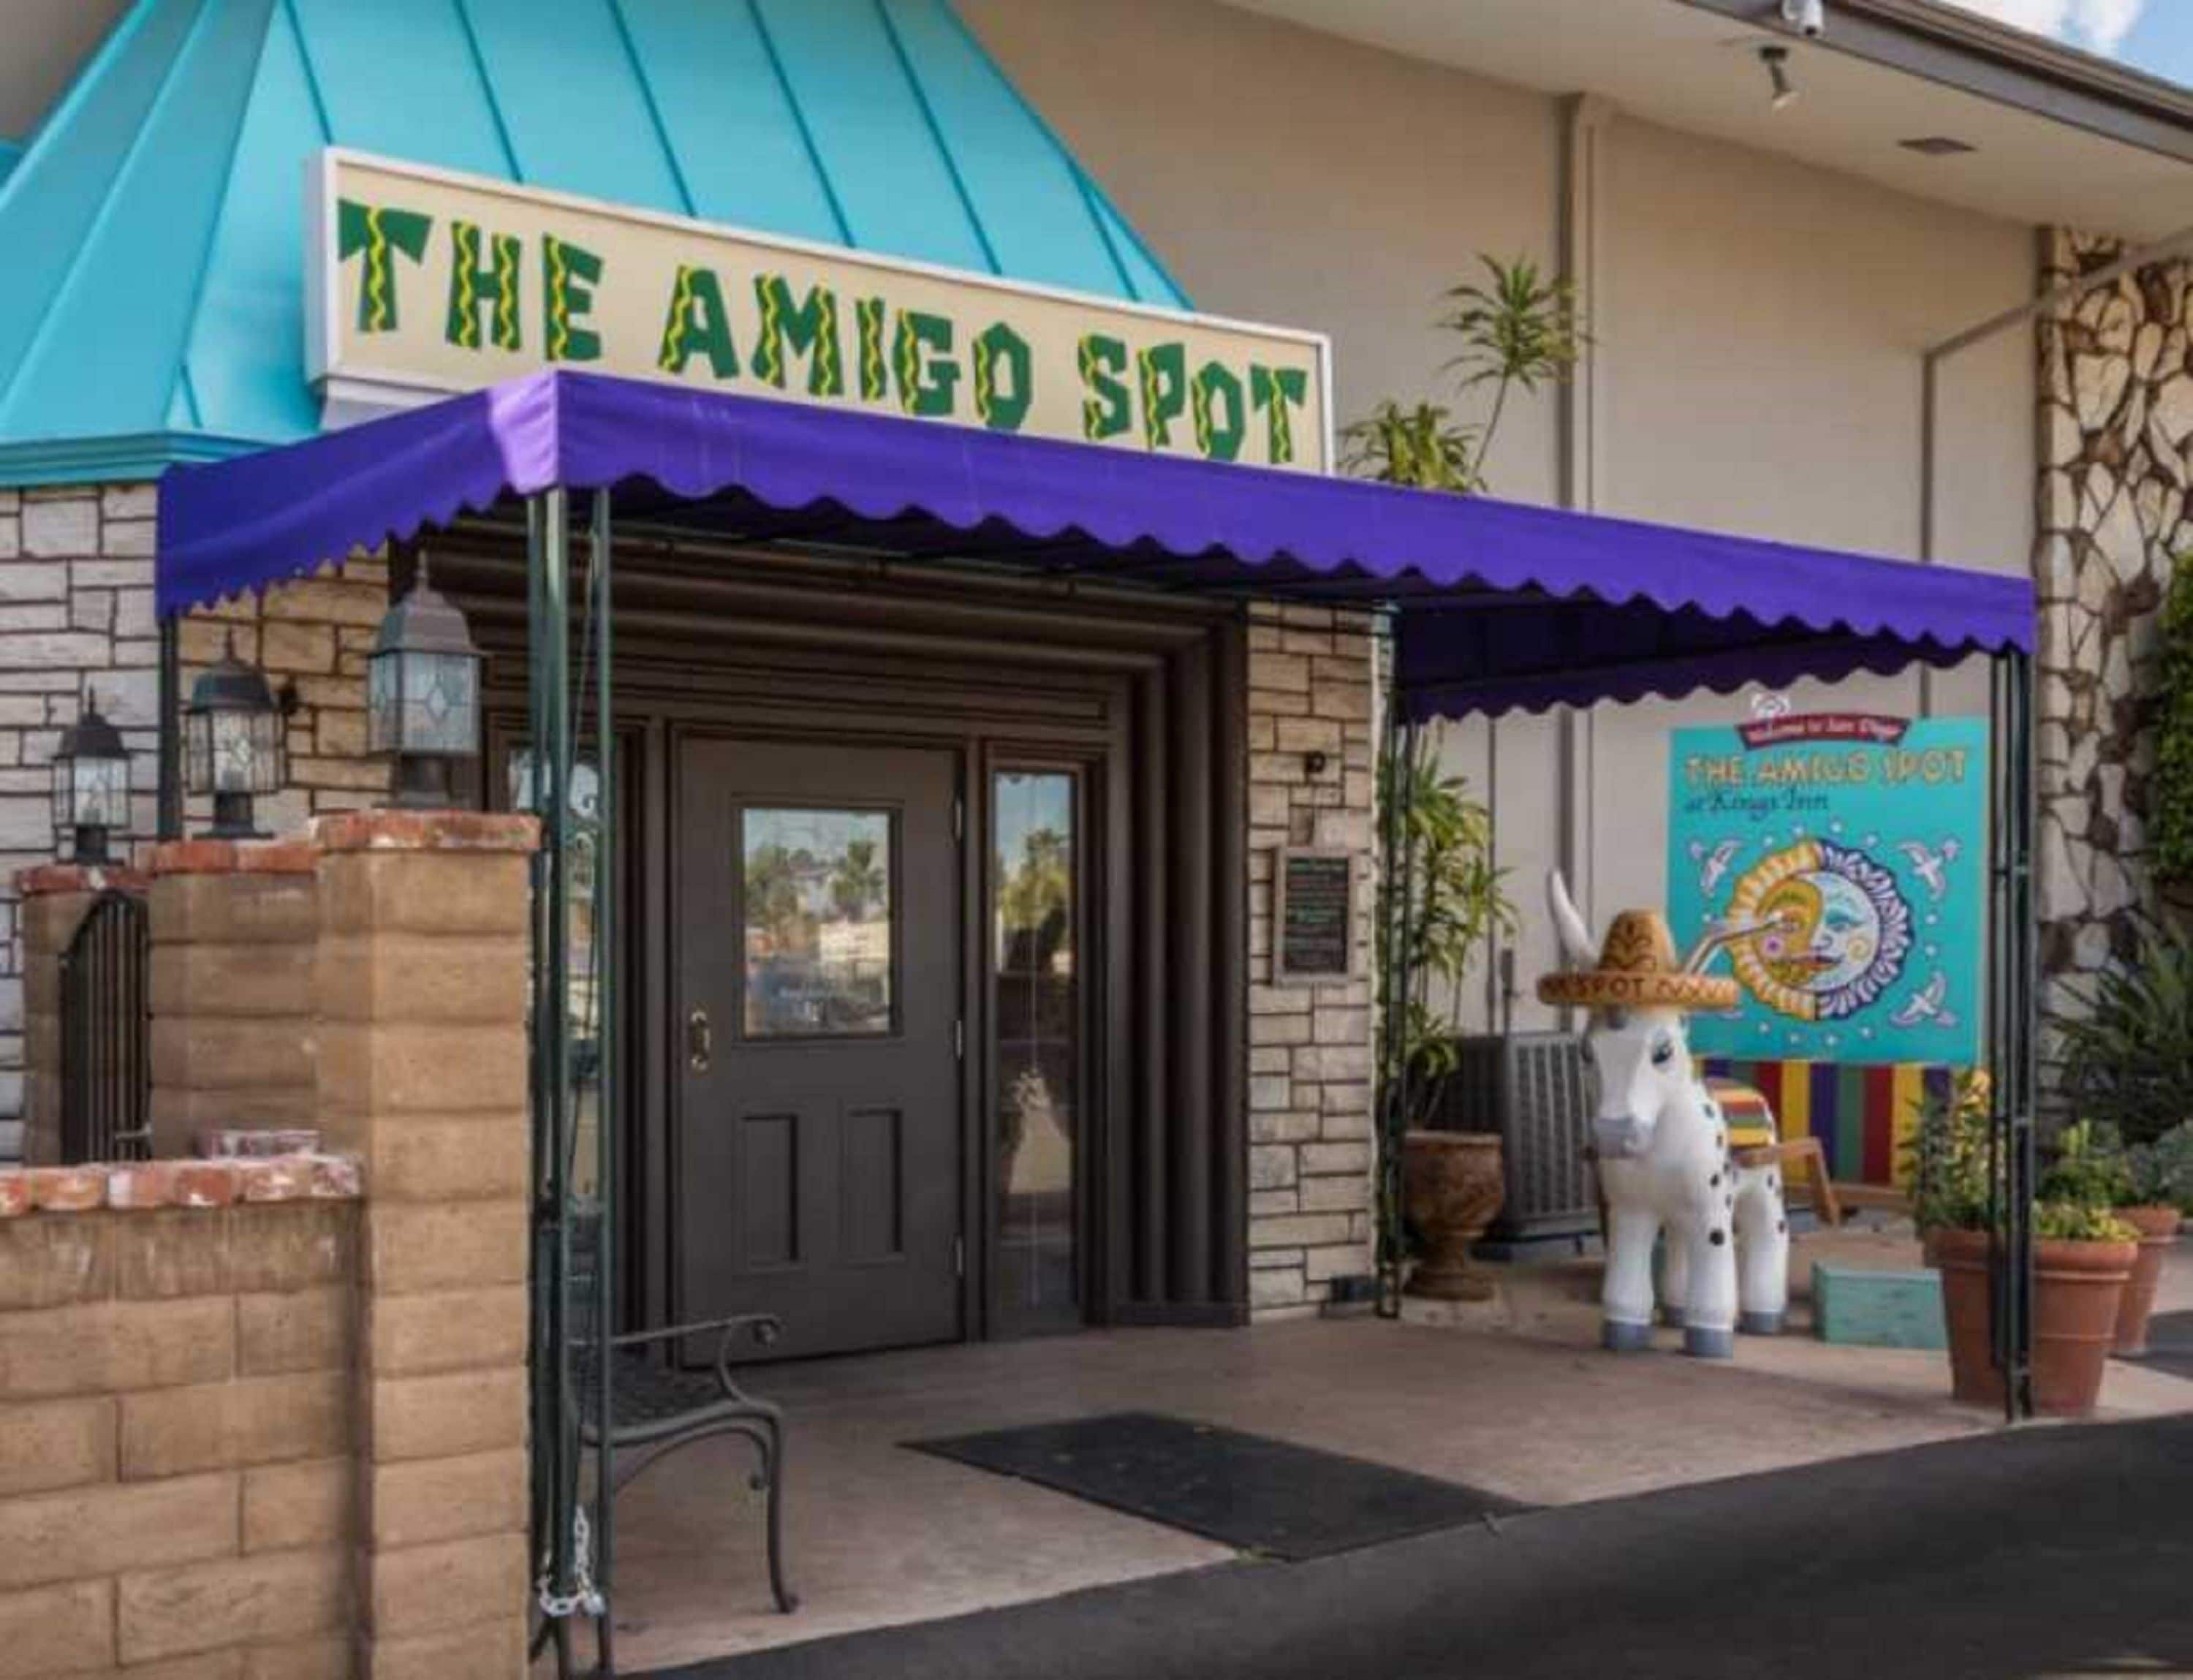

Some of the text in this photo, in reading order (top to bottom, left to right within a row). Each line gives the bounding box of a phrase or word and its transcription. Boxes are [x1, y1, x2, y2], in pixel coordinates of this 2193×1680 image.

[338, 198, 1307, 463] THE AMIGO SPOT
[1687, 748, 1966, 786] THE AMIGO SPOT
